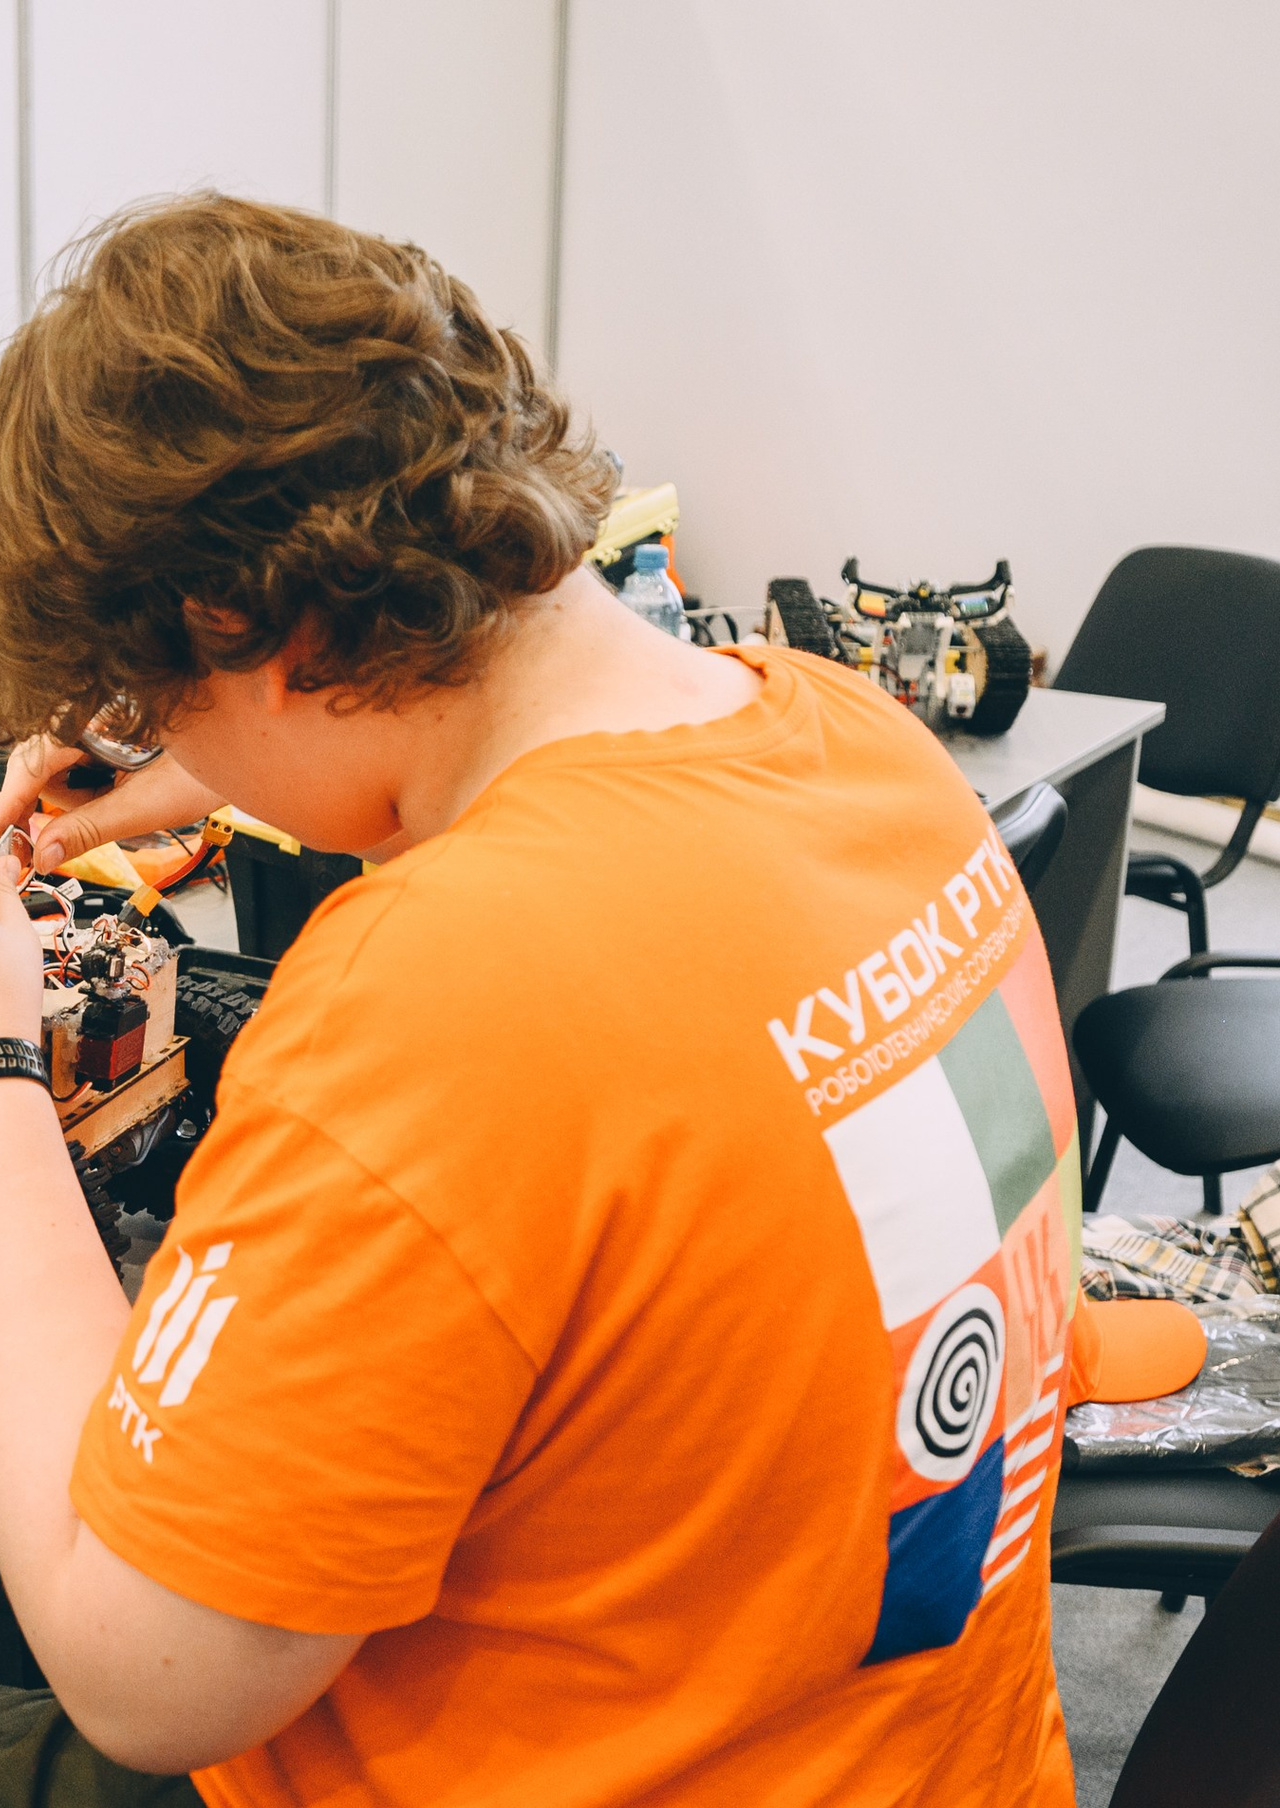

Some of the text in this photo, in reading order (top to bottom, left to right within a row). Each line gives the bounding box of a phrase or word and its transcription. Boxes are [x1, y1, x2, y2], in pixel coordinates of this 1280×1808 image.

[766, 823, 1015, 1083] КУБОК РТК
[804, 970, 973, 1116] РОБОТОТЕХНИЧЕСКИЕ
